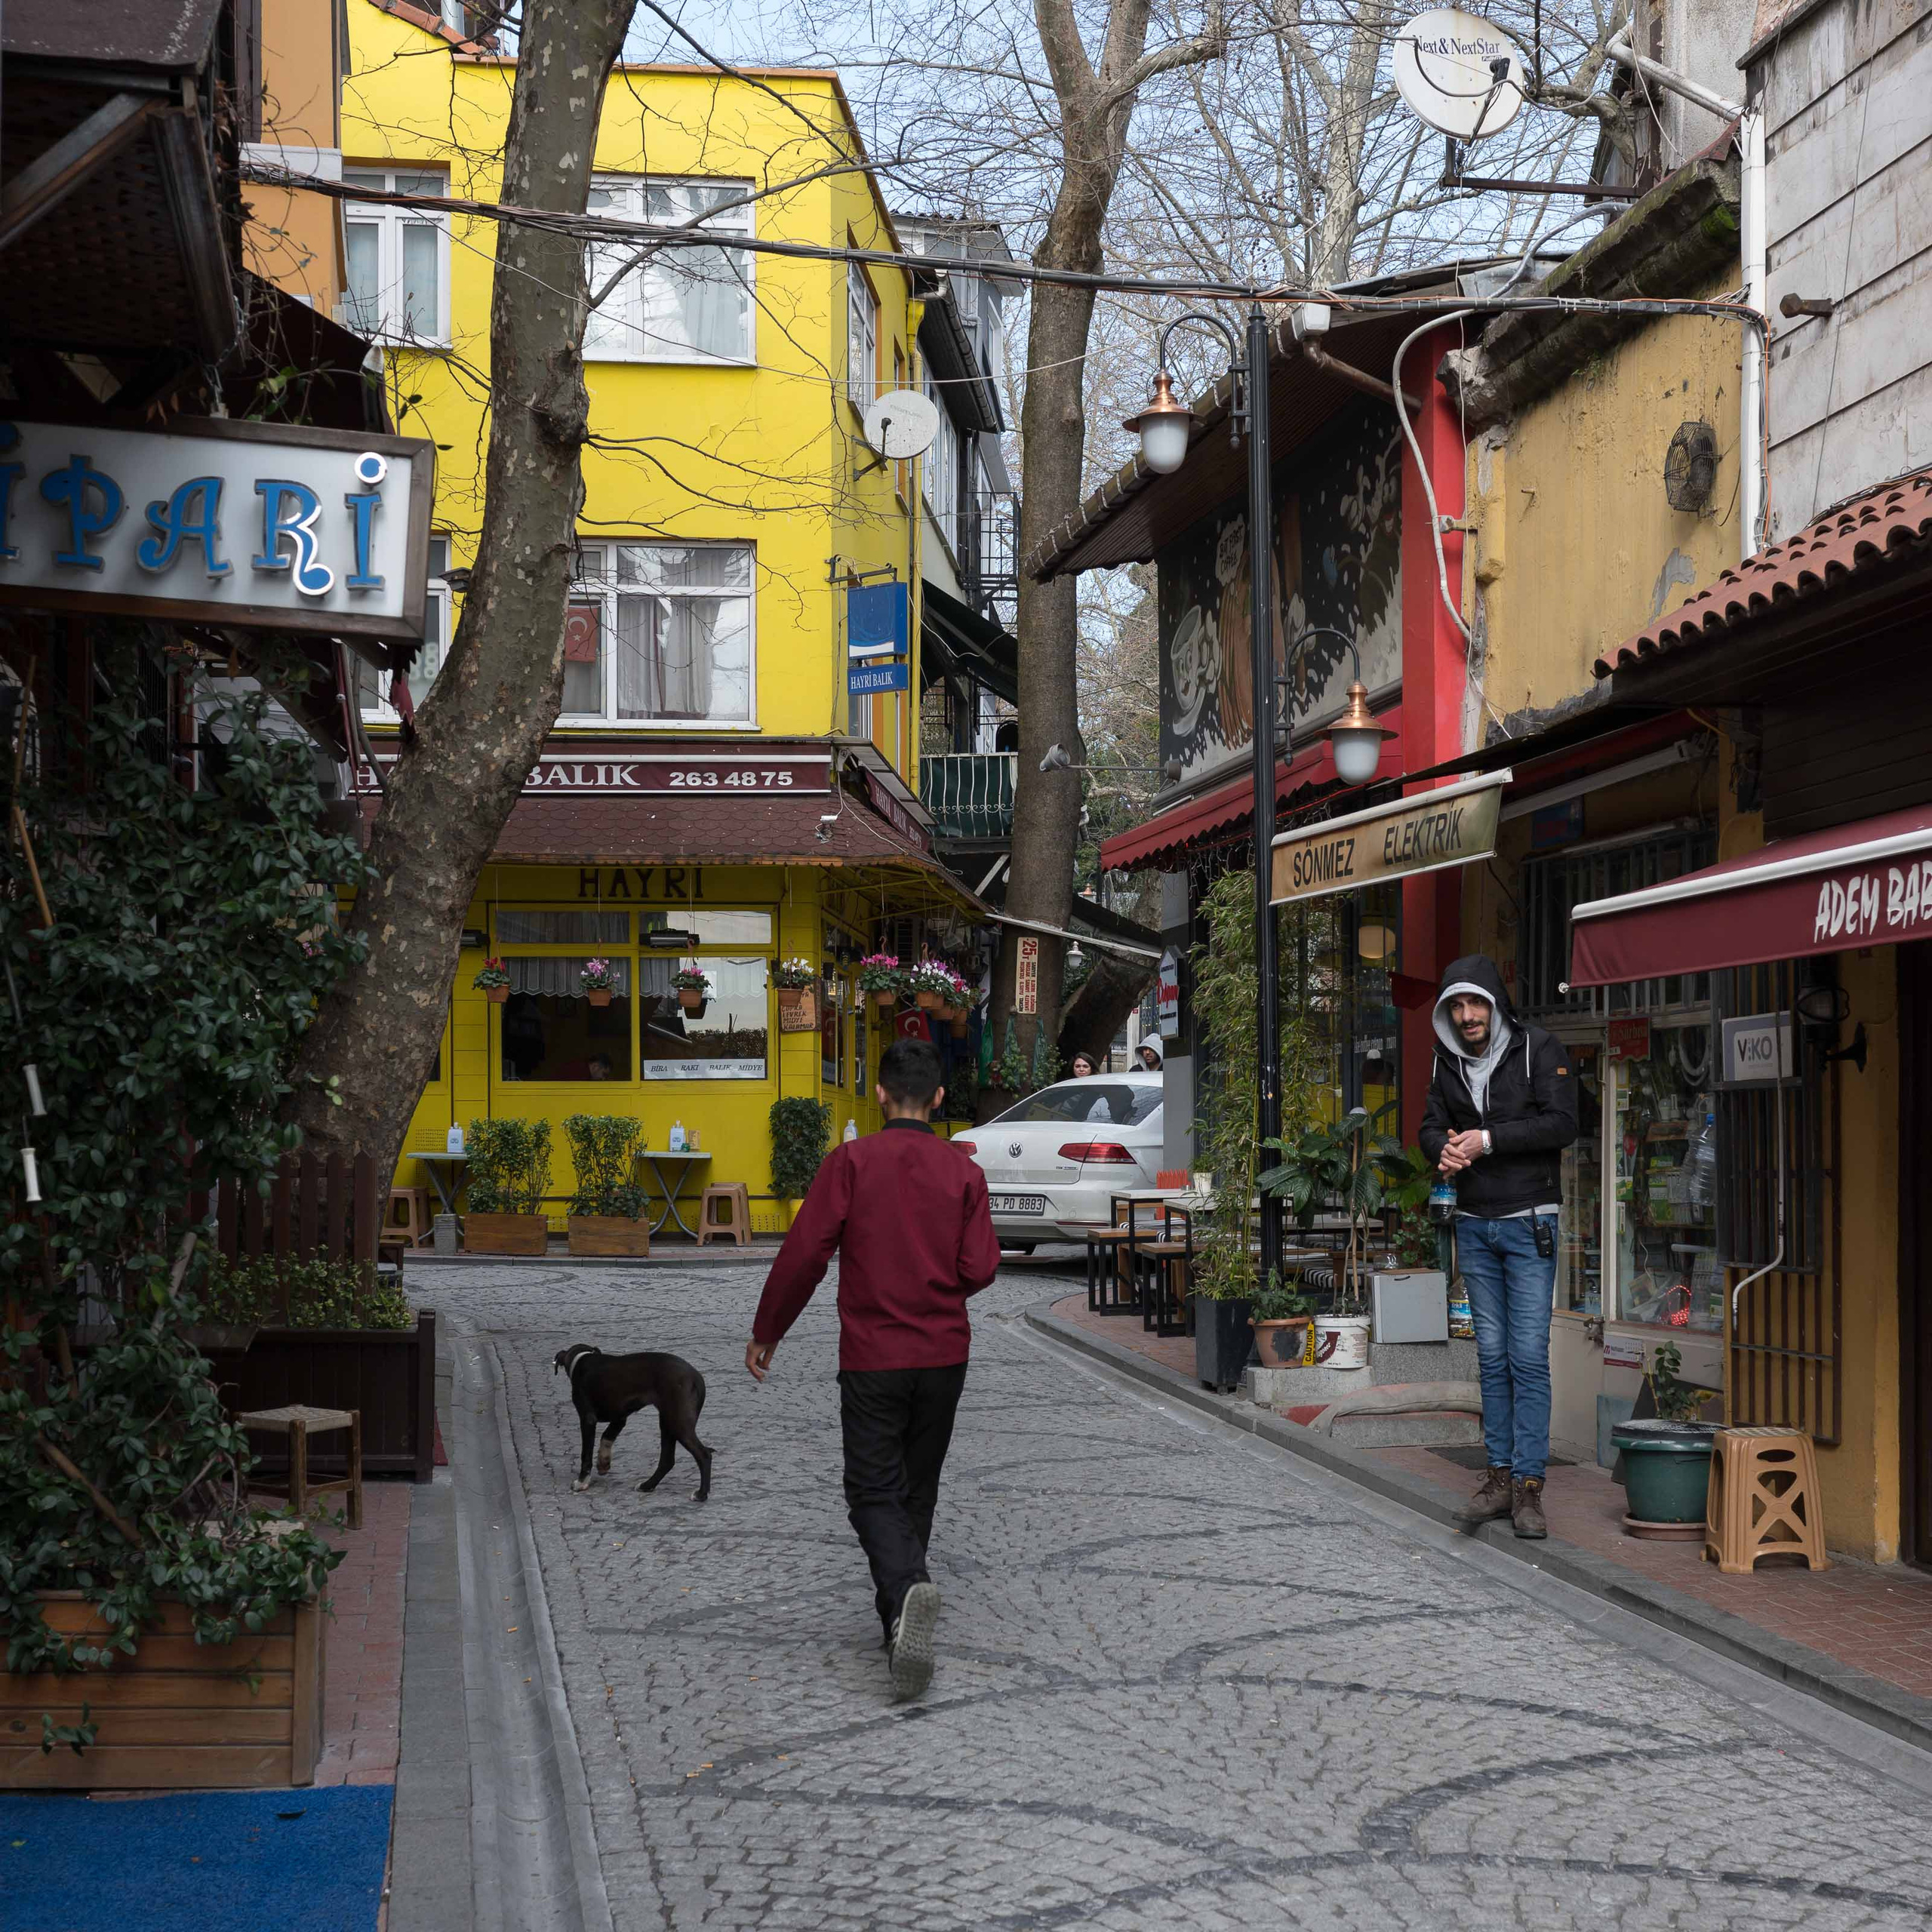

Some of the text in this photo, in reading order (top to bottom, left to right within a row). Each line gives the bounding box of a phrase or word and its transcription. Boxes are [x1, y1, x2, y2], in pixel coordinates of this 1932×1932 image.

[851, 671, 894, 690] HAYRİ BALIK
[526, 764, 793, 787] BALIK 263 48 75
[1294, 801, 1464, 888] SÖNMEZ ELEKTRİK
[1814, 873, 1881, 943] ADEM
[989, 1198, 1042, 1210] 34 PD 8883
[1305, 1329, 1313, 1362] CAUTION
